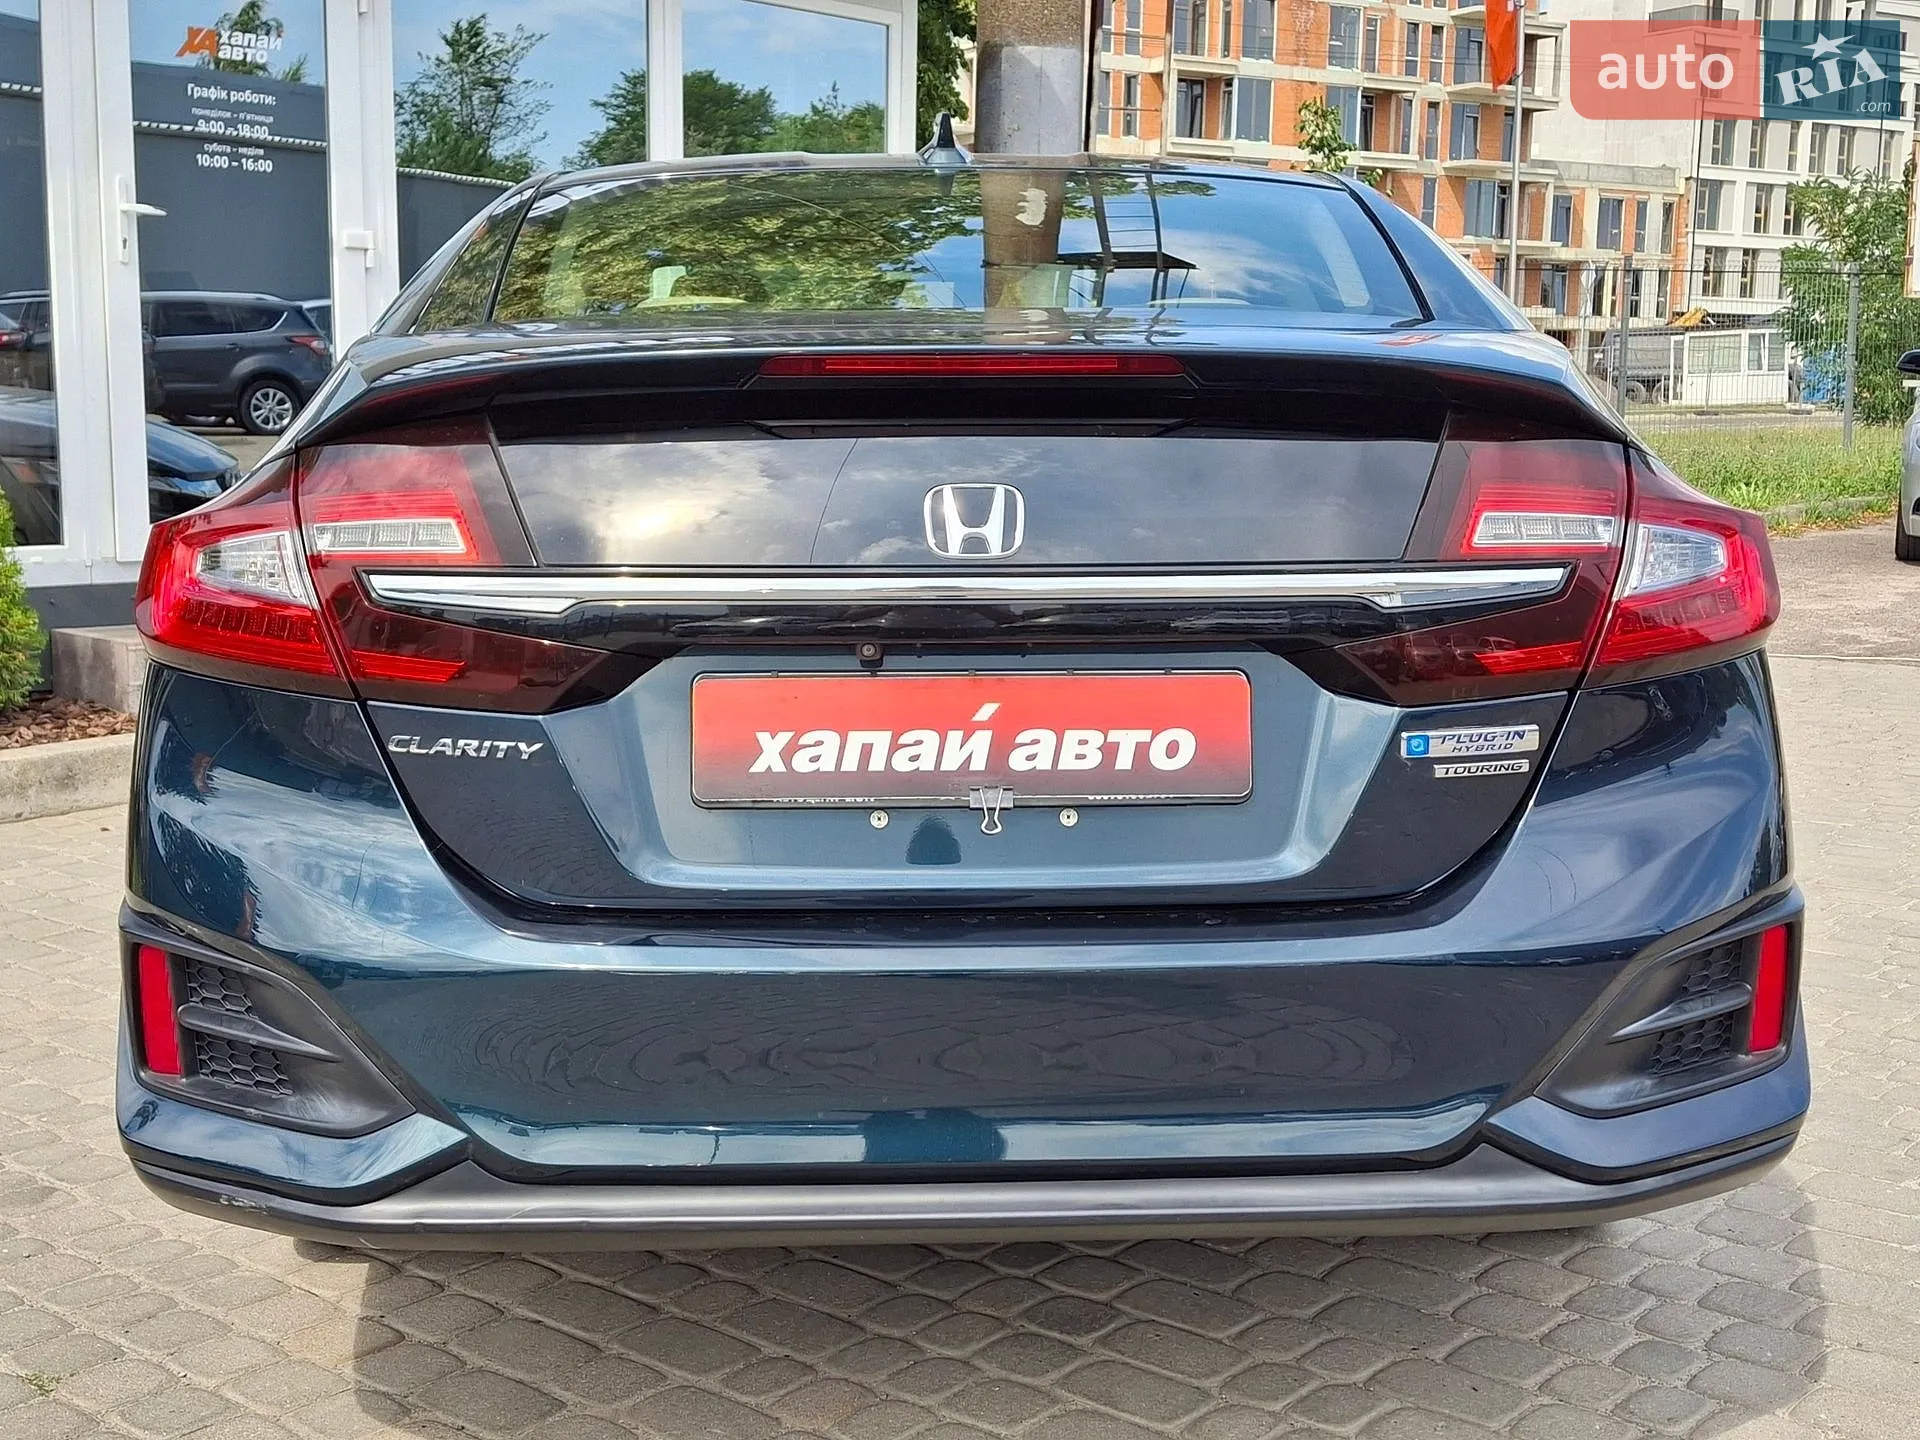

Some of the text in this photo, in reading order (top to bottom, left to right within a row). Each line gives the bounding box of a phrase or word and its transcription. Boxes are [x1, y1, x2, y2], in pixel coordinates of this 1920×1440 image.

[219, 29, 284, 50] хапай
[218, 44, 268, 63] авто
[187, 83, 277, 106] Графік роботи:
[197, 119, 225, 135] 9:00
[237, 123, 269, 138] 18:00
[195, 153, 229, 169] 10:00
[240, 157, 273, 173] 16:00
[748, 703, 1197, 773] хапай авто
[1441, 730, 1526, 744] PLUG-IN
[387, 734, 544, 760] CLARITY
[1451, 743, 1513, 753] HYBRID
[1443, 763, 1524, 776] TOURING
